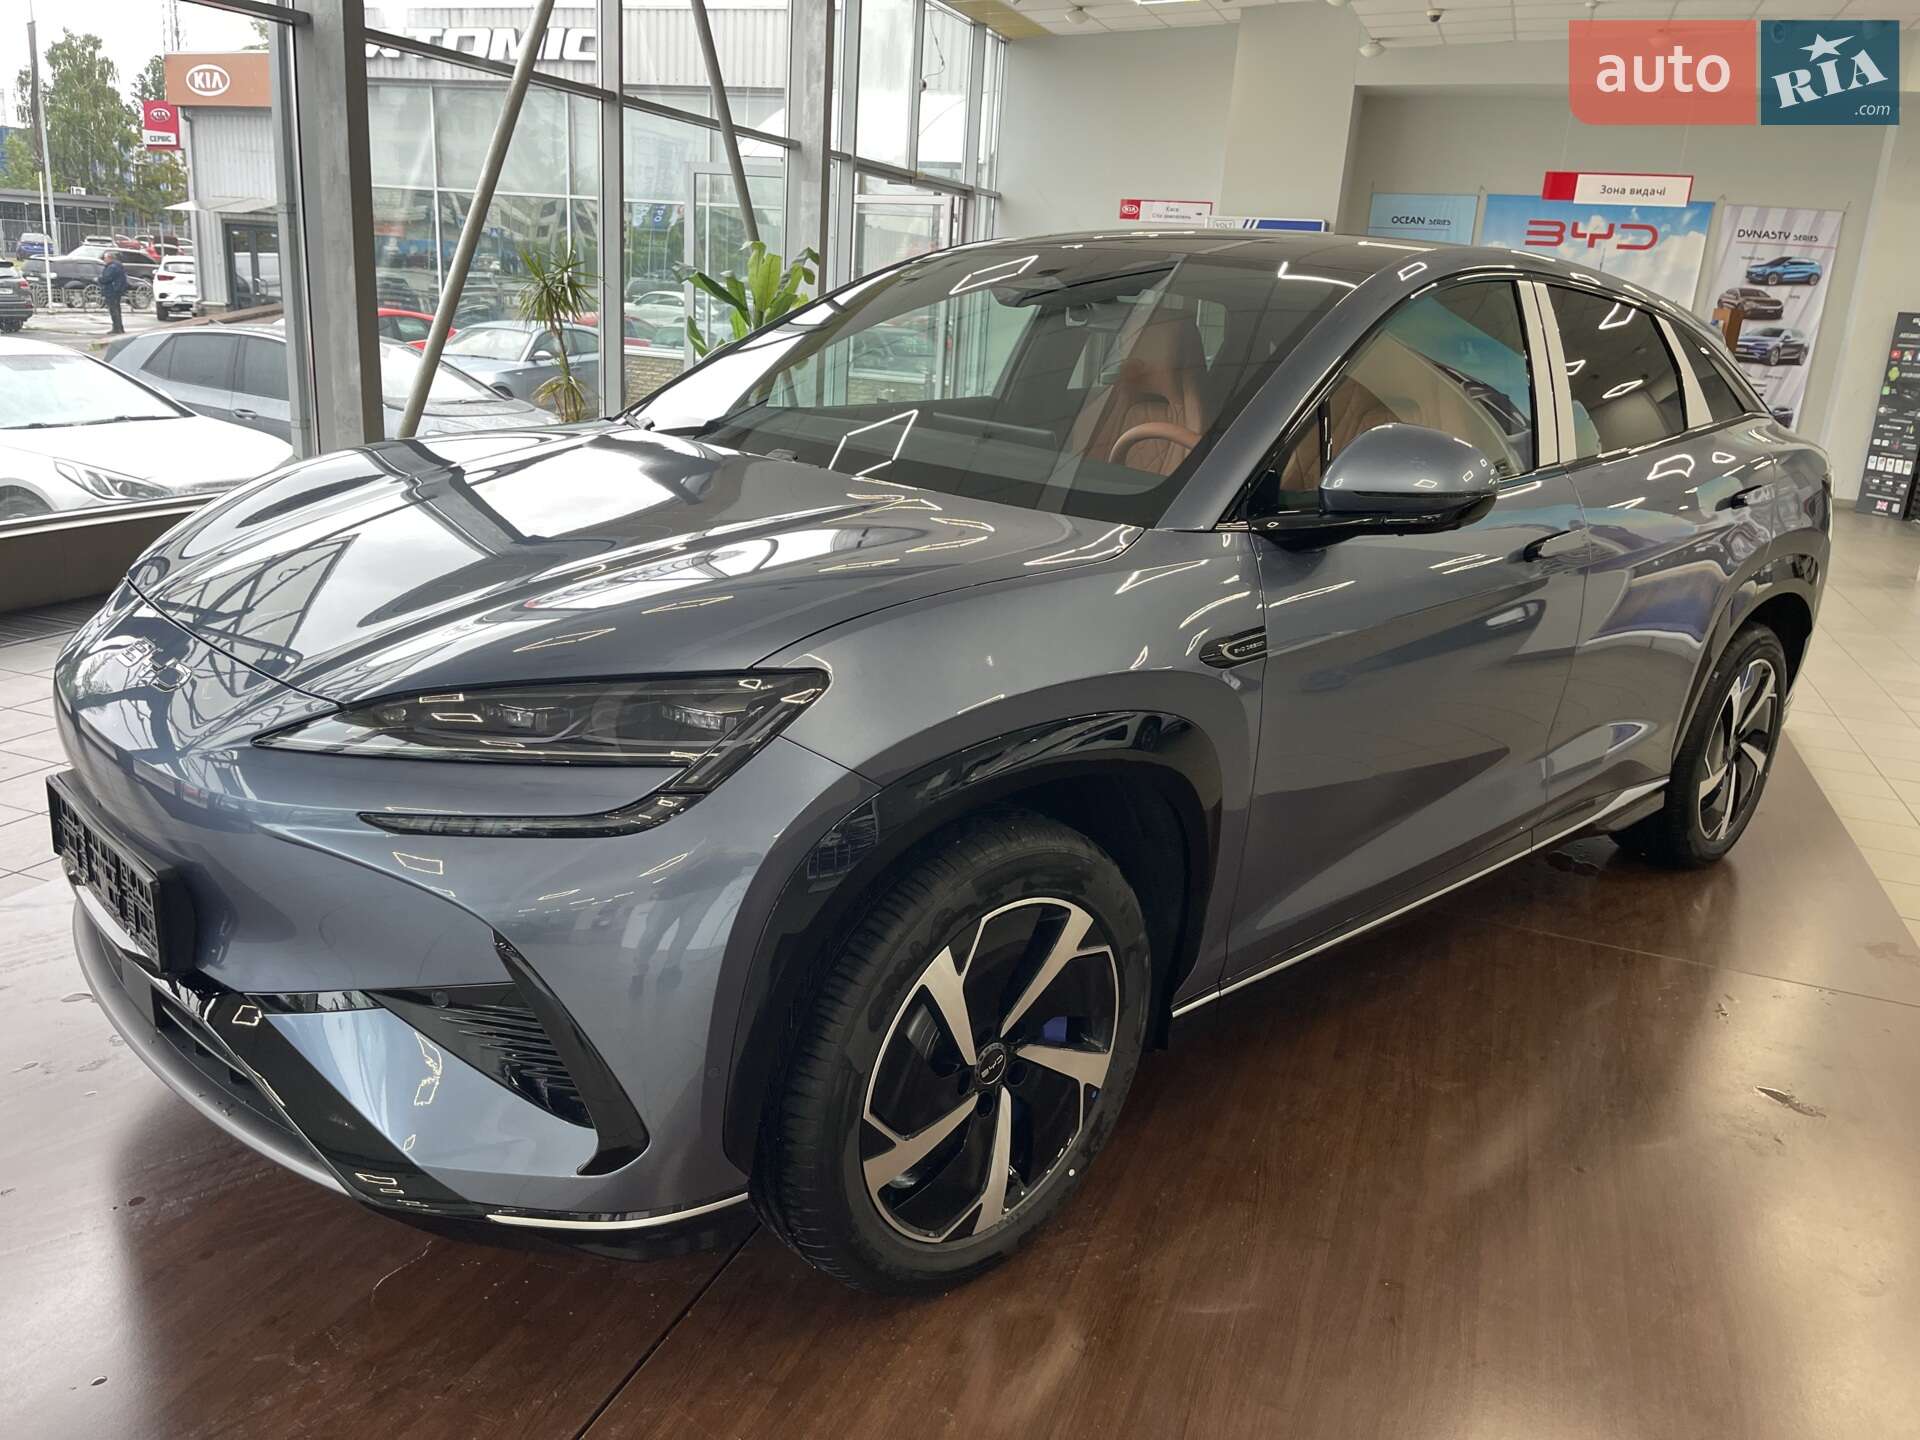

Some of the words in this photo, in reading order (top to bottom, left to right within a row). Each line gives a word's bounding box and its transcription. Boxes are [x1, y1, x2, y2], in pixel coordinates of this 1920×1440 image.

[193, 72, 223, 89] KIA
[1599, 184, 1626, 195] Зона
[1629, 186, 1666, 197] видачі
[1391, 215, 1425, 225] OCEAN
[1524, 219, 1659, 251] BYD
[1737, 229, 1792, 241] DYNASTY
[1792, 234, 1819, 242] SERIES
